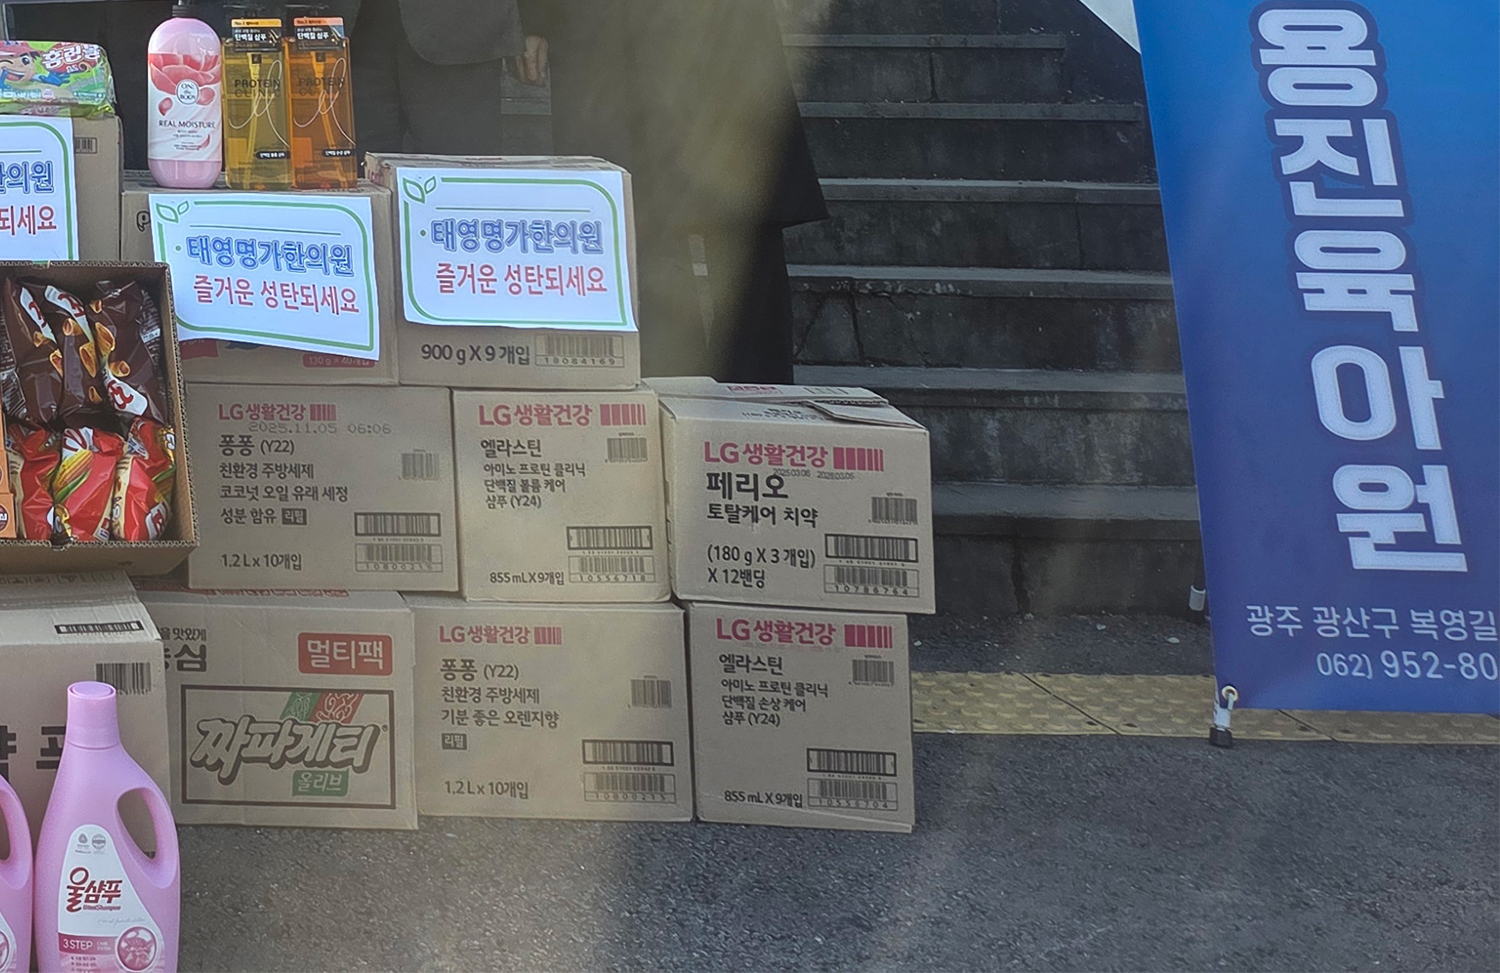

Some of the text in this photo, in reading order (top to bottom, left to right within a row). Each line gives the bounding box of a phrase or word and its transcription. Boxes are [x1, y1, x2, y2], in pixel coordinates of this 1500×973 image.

[235, 79, 280, 88] PROTEIN
[431, 218, 604, 254] 태영명가한의원
[186, 236, 354, 277] 태영명가한의원
[436, 262, 608, 296] 즐거운 성탄되세요
[194, 274, 359, 315] 즐거운 성탄되세요
[1256, 7, 1468, 574] 용진육아원
[421, 344, 530, 366] 900 g X 개입
[219, 434, 295, 456] 퐁퐁 (Y22)
[480, 438, 542, 459] 엘라스틴
[219, 463, 314, 480] 친환경 주방세제
[484, 463, 586, 477] 아미노 프로틴 클리닉
[219, 486, 348, 502] 코코넛 오일 유래 세정
[484, 479, 566, 493] 단백질 볼륨 케어
[706, 472, 789, 502] 페리오
[485, 496, 542, 510] 샴푸 (Y24)
[220, 508, 277, 525] 성분 함유
[707, 503, 818, 528] 토탈케어 치약
[263, 553, 302, 571] 10개입
[707, 545, 816, 569] (180 개입)
[707, 569, 766, 589] X 12밴딩
[1246, 605, 1499, 641] 광주 광산구 복영길
[172, 628, 207, 641] 맛있게
[307, 640, 384, 670] 멀티팩
[719, 654, 783, 676] 엘라스틴
[1316, 650, 1498, 680] 062) 952-80
[440, 659, 520, 681] 퐁퐁 (Y22)
[441, 687, 540, 704] 친환경 주방세제
[721, 679, 828, 698] 아미노 프로틴 클리닉
[721, 695, 806, 713] 단백질 손상 케어
[441, 710, 559, 729] 기분 좋은 오렌지향
[722, 712, 781, 728] 샴푸 (Y24)
[190, 715, 380, 785] 짜파게티
[298, 772, 342, 792] 올리브
[488, 782, 529, 799] 10개입
[66, 866, 123, 913] 울샴푸
